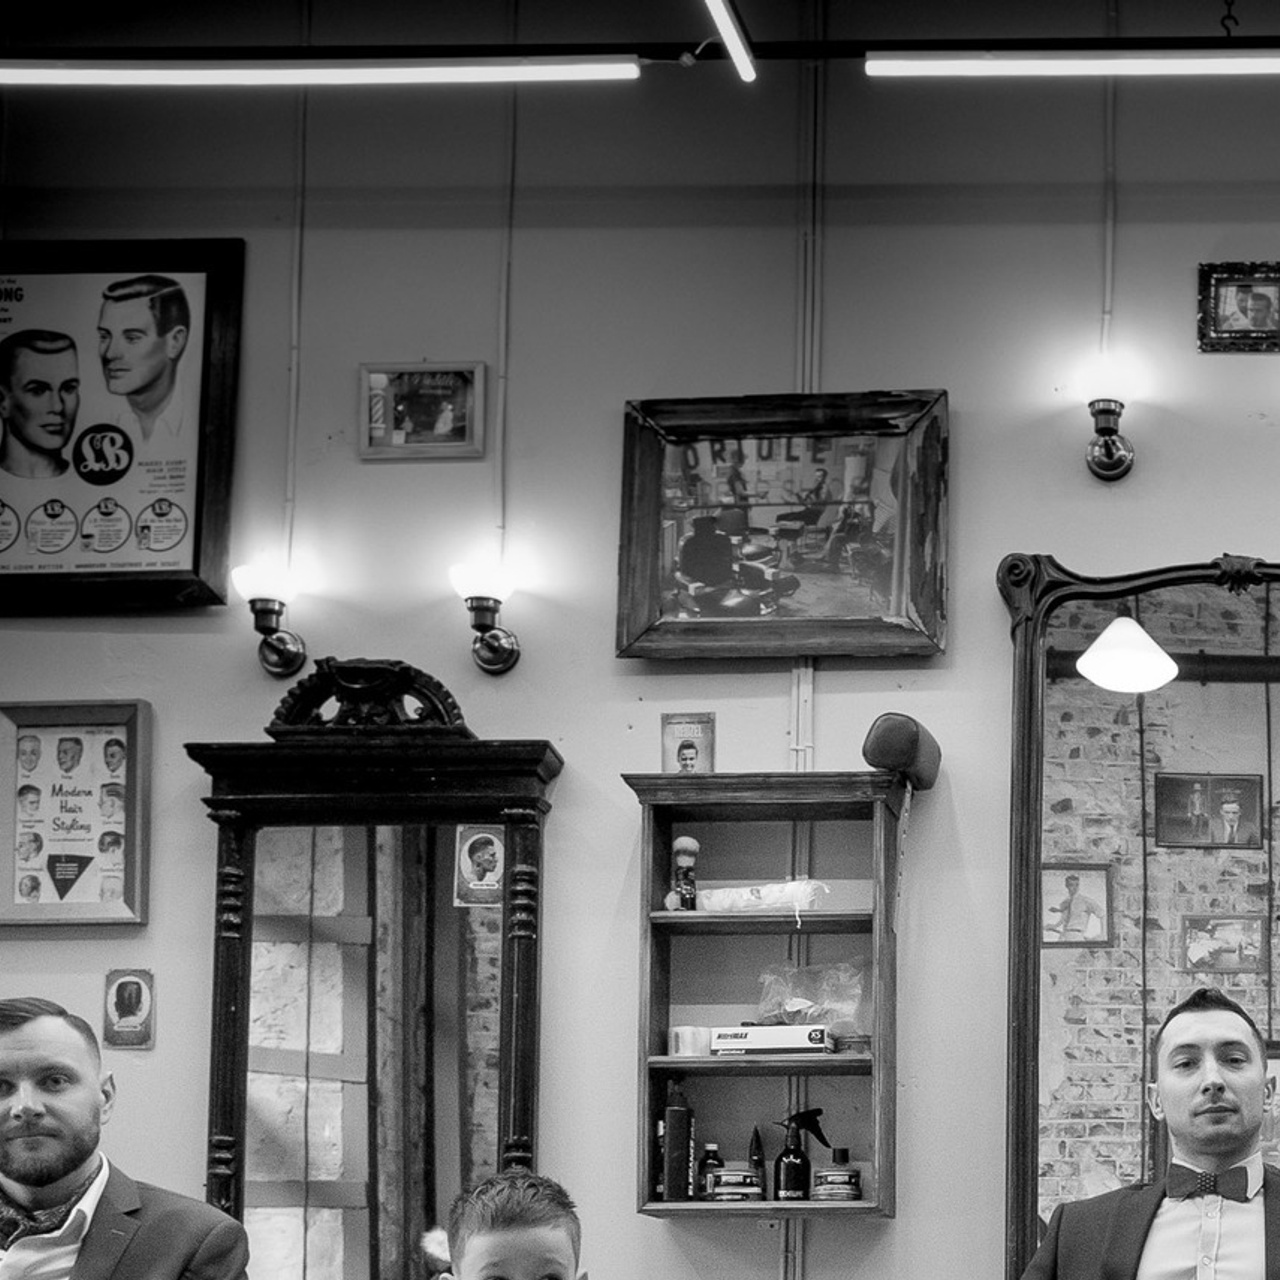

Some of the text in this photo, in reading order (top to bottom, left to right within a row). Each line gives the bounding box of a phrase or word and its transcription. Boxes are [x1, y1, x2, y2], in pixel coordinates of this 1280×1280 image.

[51, 783, 94, 798] Modern
[60, 799, 83, 814] Hair
[52, 817, 92, 835] Styling
